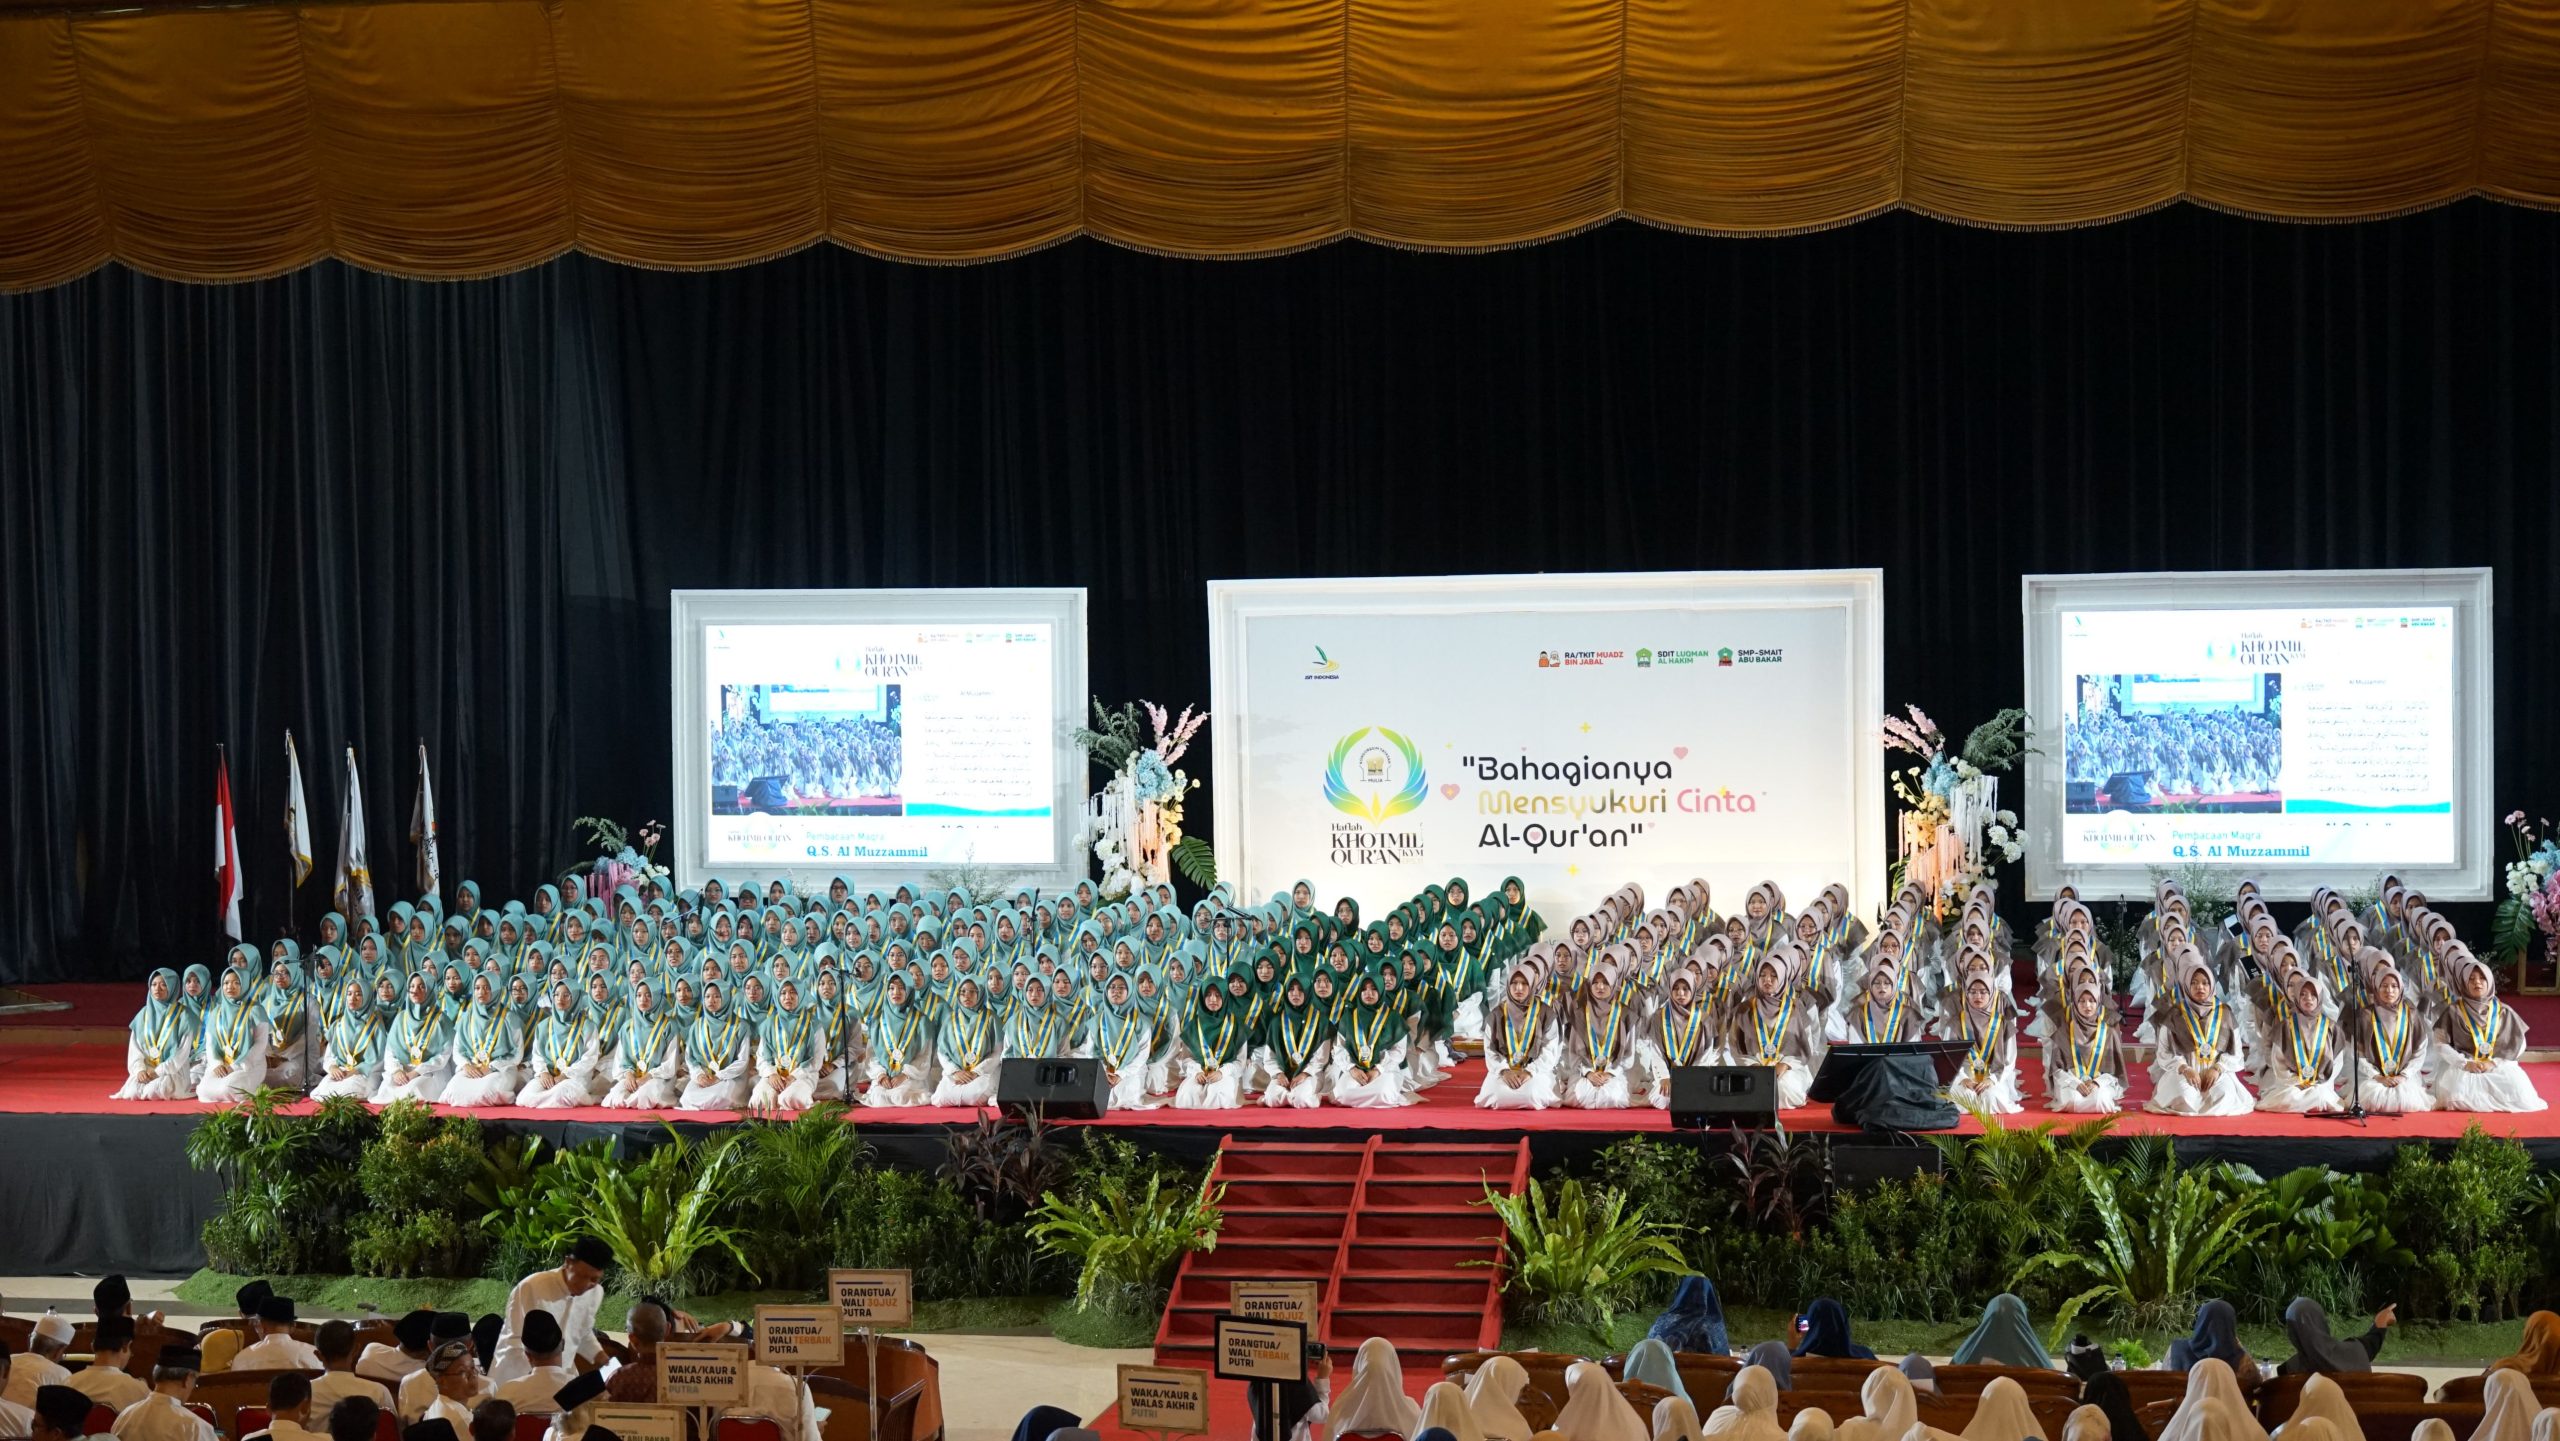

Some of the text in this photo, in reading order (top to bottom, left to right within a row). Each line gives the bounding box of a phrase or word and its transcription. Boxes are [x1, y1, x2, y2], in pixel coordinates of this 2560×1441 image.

[1564, 651, 1595, 659] RA/TKIT
[1676, 650, 1709, 658] LUQMAN
[1564, 658, 1578, 666] BIN
[1478, 788, 1756, 820] Mensyukuri Cinta
[1331, 822, 1362, 831] Haflah
[1331, 832, 1424, 848] KHOTMIL
[837, 846, 849, 857] Al
[855, 846, 928, 857] Muzzammil
[1402, 849, 1424, 857] KYM
[2208, 846, 2221, 856] Al
[2227, 846, 2310, 857] Muzzammil
[1331, 849, 1401, 868] QUR'AN
[841, 1288, 896, 1297] ORANGTUA/
[841, 1298, 865, 1306] WALI
[1244, 1301, 1302, 1310] ORANGTUA/
[768, 1326, 823, 1335] ORANGTUA/
[768, 1336, 832, 1344] WALI TERBAIK
[1228, 1338, 1281, 1350] ORANGTUA/
[769, 1346, 798, 1354] PUTRA
[1228, 1348, 1290, 1360] WALI TERBAIK
[1228, 1357, 1254, 1367] PUTRI
[668, 1365, 736, 1375] WAKA/KAUR &
[668, 1376, 734, 1384] WALAS AKHIR
[669, 1385, 699, 1393] PUTRA
[1131, 1388, 1198, 1400] WAKA/KAUR &
[1131, 1398, 1195, 1411] WALAS AKHIR
[1131, 1408, 1158, 1418] PUTRI
